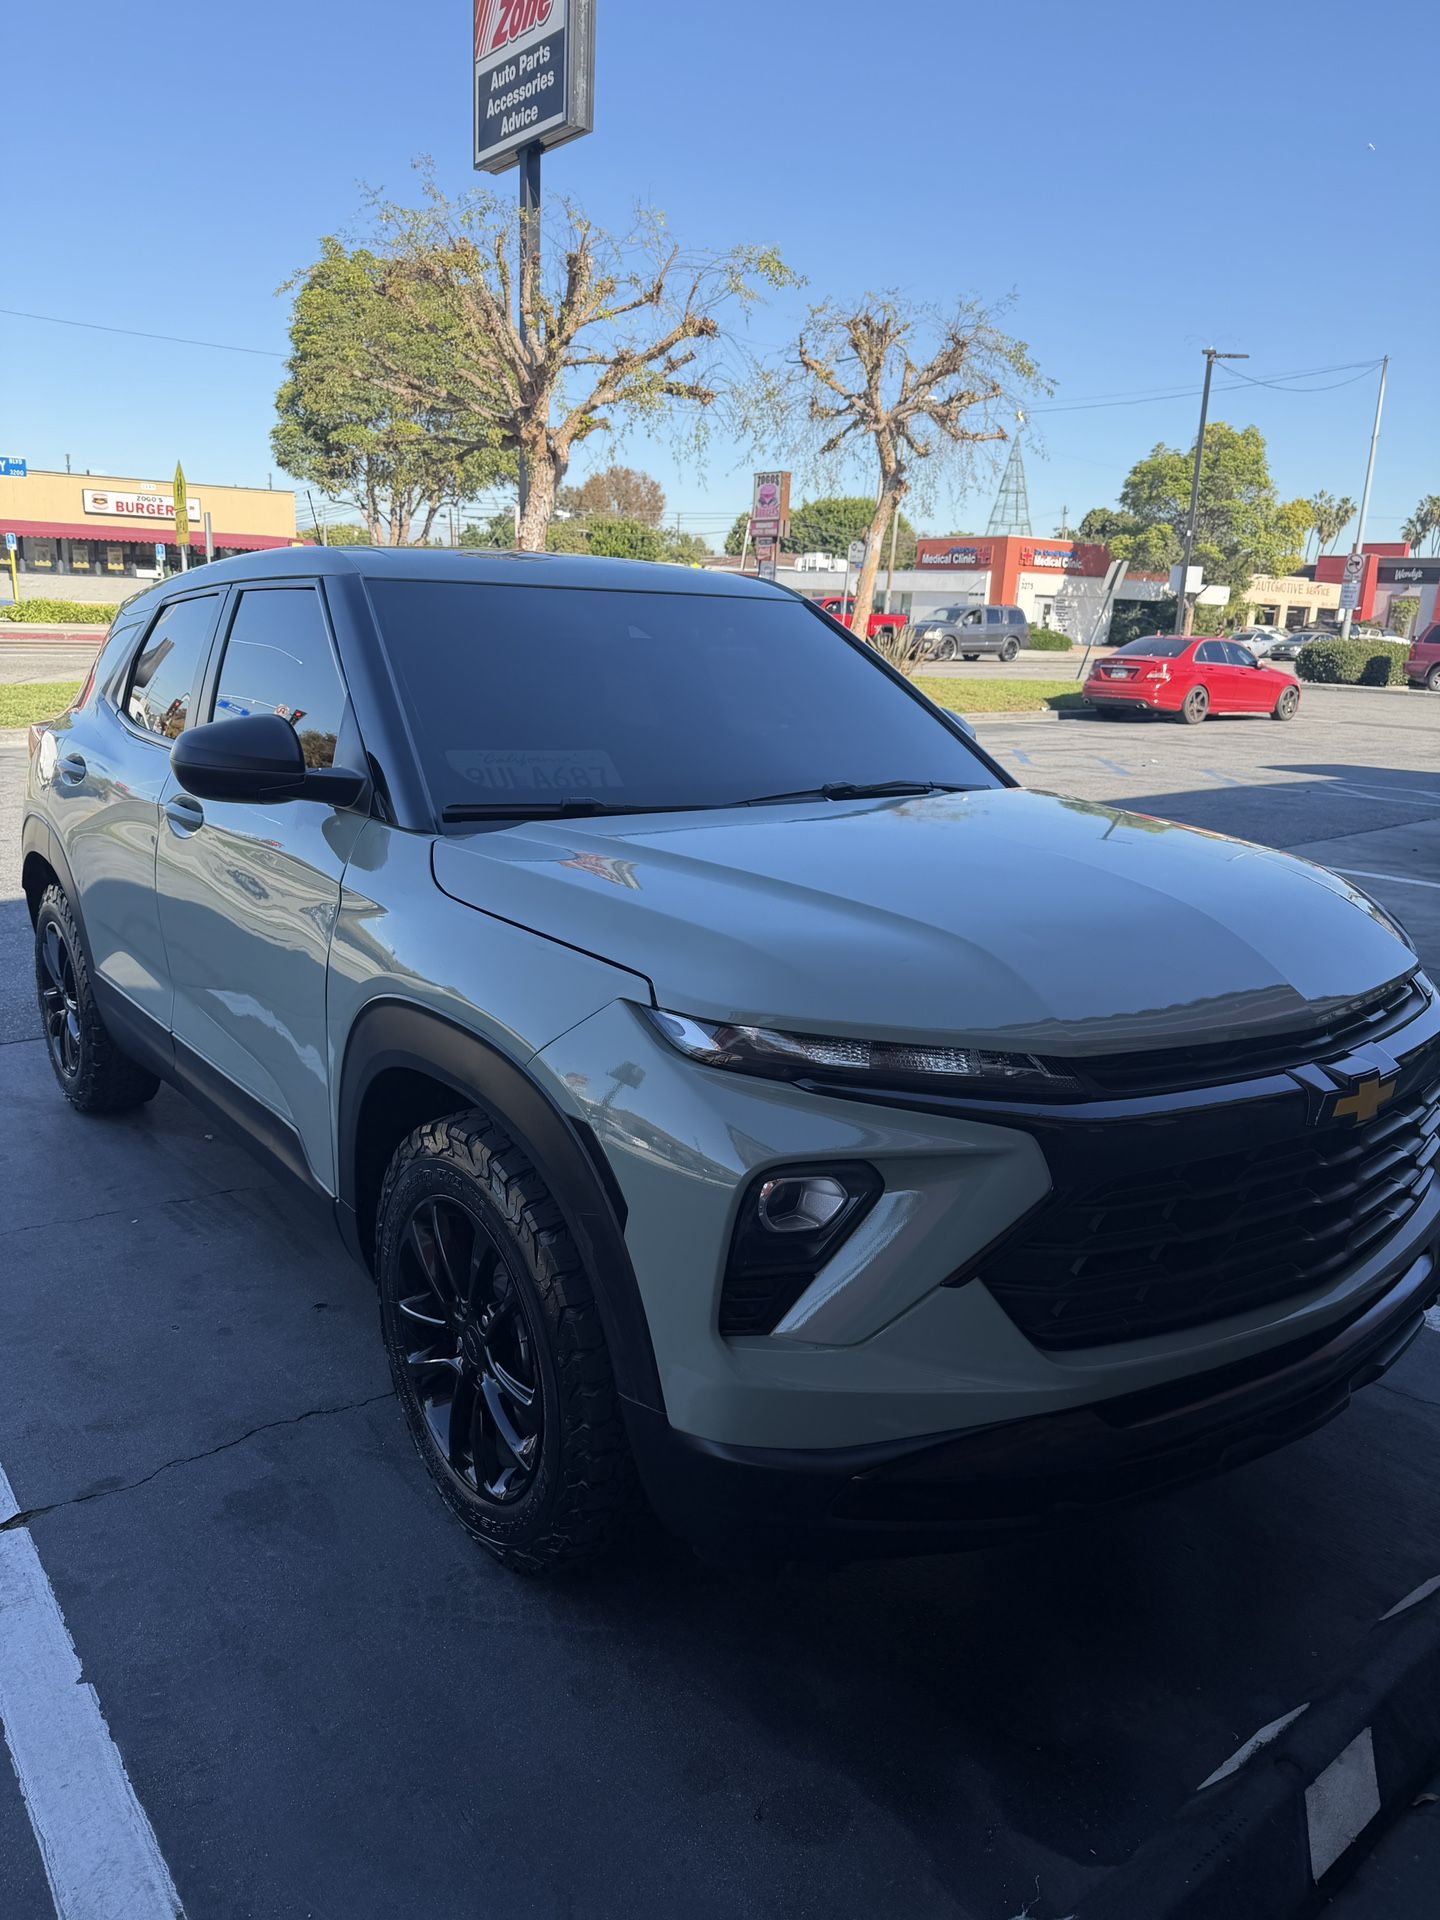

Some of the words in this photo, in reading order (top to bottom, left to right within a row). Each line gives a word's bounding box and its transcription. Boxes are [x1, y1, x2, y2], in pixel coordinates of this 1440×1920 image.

[490, 65, 516, 91] Auto
[519, 45, 550, 76] Parts
[486, 70, 554, 119] Accessories
[500, 105, 538, 137] Advice
[922, 553, 952, 564] Medical
[952, 553, 977, 564] Clinic
[1033, 555, 1062, 568] Medical
[1062, 557, 1083, 569] Clinic
[1394, 567, 1424, 581] Wendy's
[1255, 580, 1304, 595] AUTOMOTIVE
